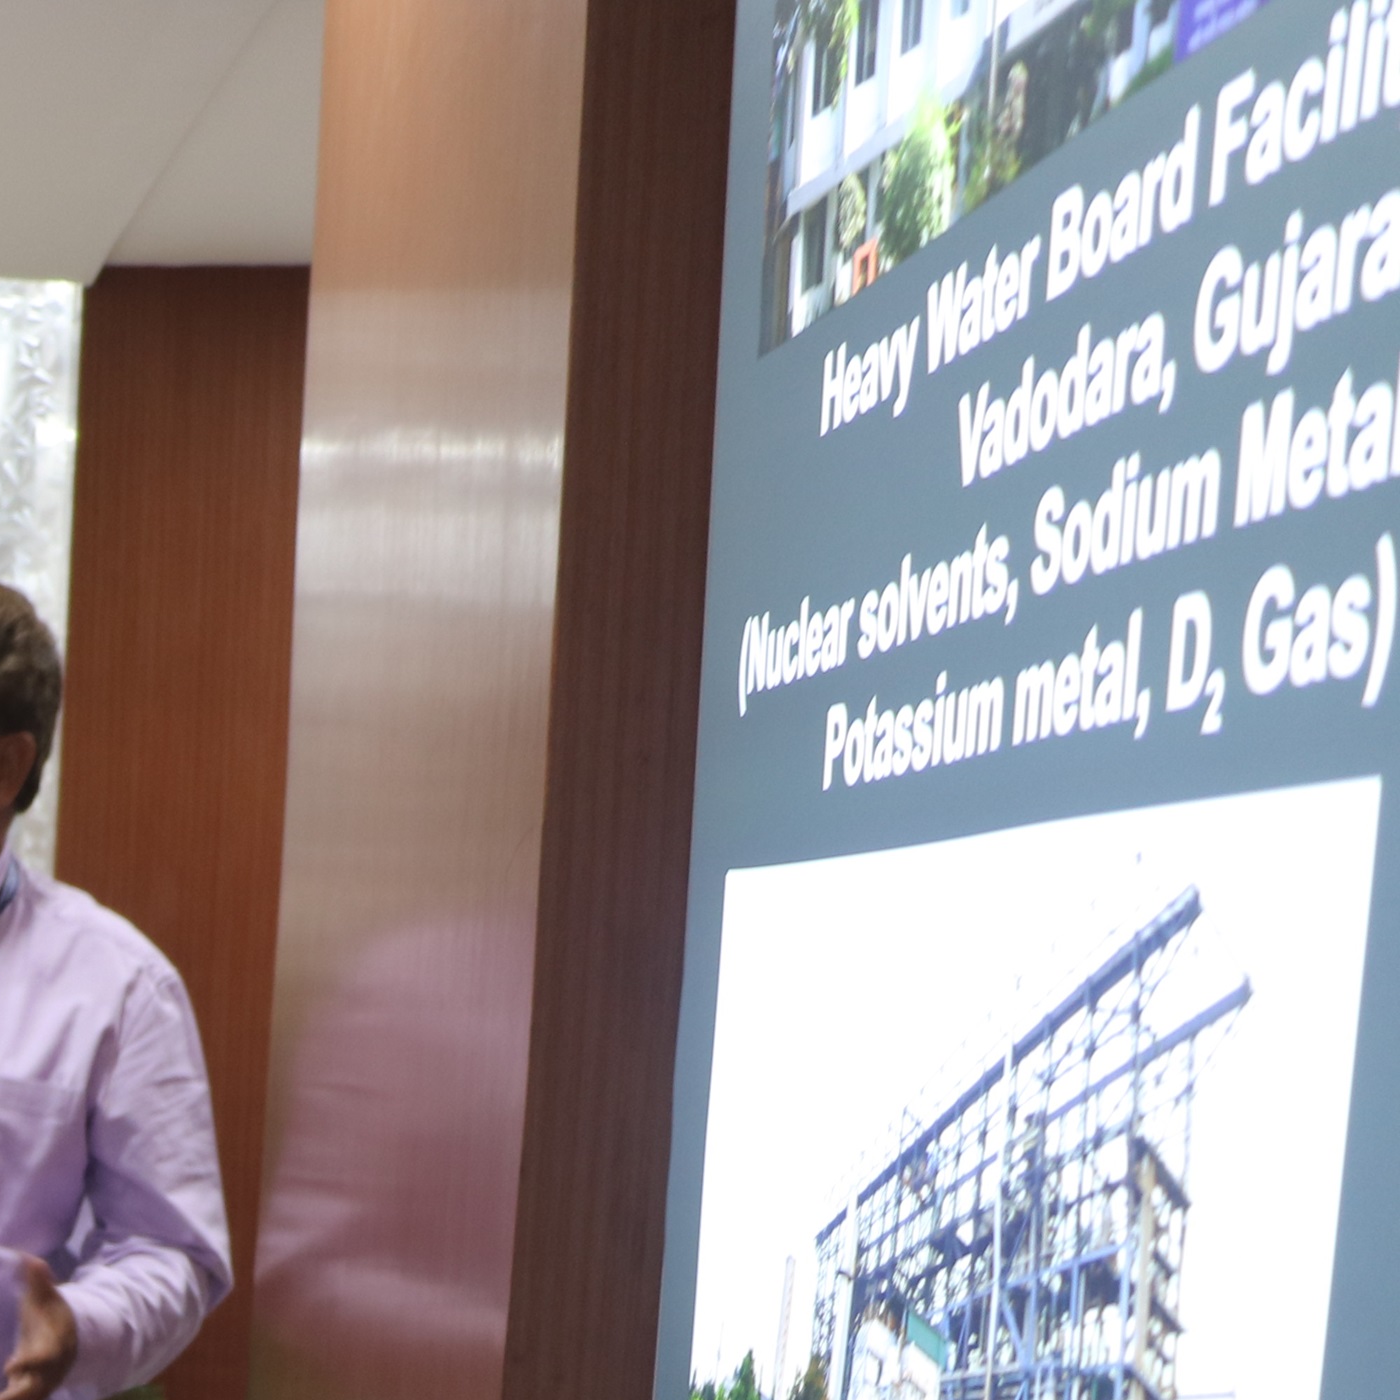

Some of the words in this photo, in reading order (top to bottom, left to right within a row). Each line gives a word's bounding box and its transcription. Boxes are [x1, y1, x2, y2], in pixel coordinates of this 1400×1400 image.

[819, 314, 921, 438] Heavy
[926, 235, 1043, 375] Water
[1045, 103, 1201, 303] Board
[958, 312, 1178, 488] Vadodara,
[738, 595, 856, 717] (Nuclear
[857, 523, 1019, 660] solvents,
[1030, 449, 1221, 596] Sodium
[822, 675, 1005, 792] Potassium
[1012, 606, 1151, 747] metal,
[1242, 532, 1397, 708] Gas)
